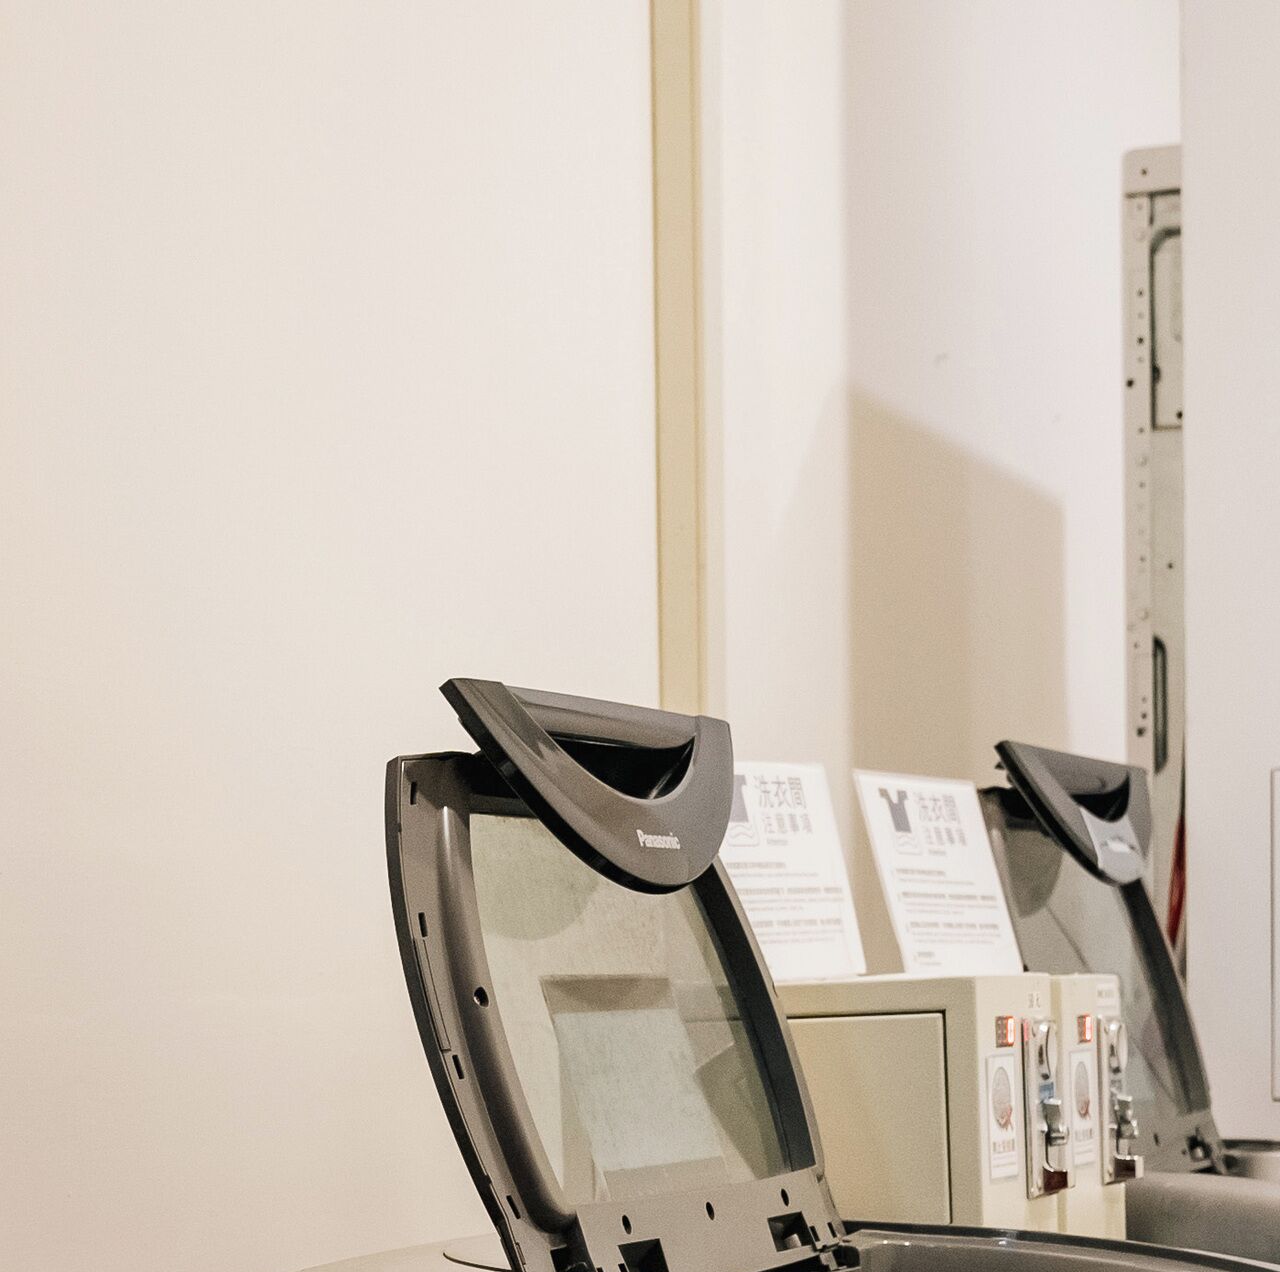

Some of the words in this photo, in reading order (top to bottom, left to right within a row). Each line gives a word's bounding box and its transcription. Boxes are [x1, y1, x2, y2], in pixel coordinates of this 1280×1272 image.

[753, 774, 807, 809] 洗衣間
[636, 829, 681, 850] Panasonic
